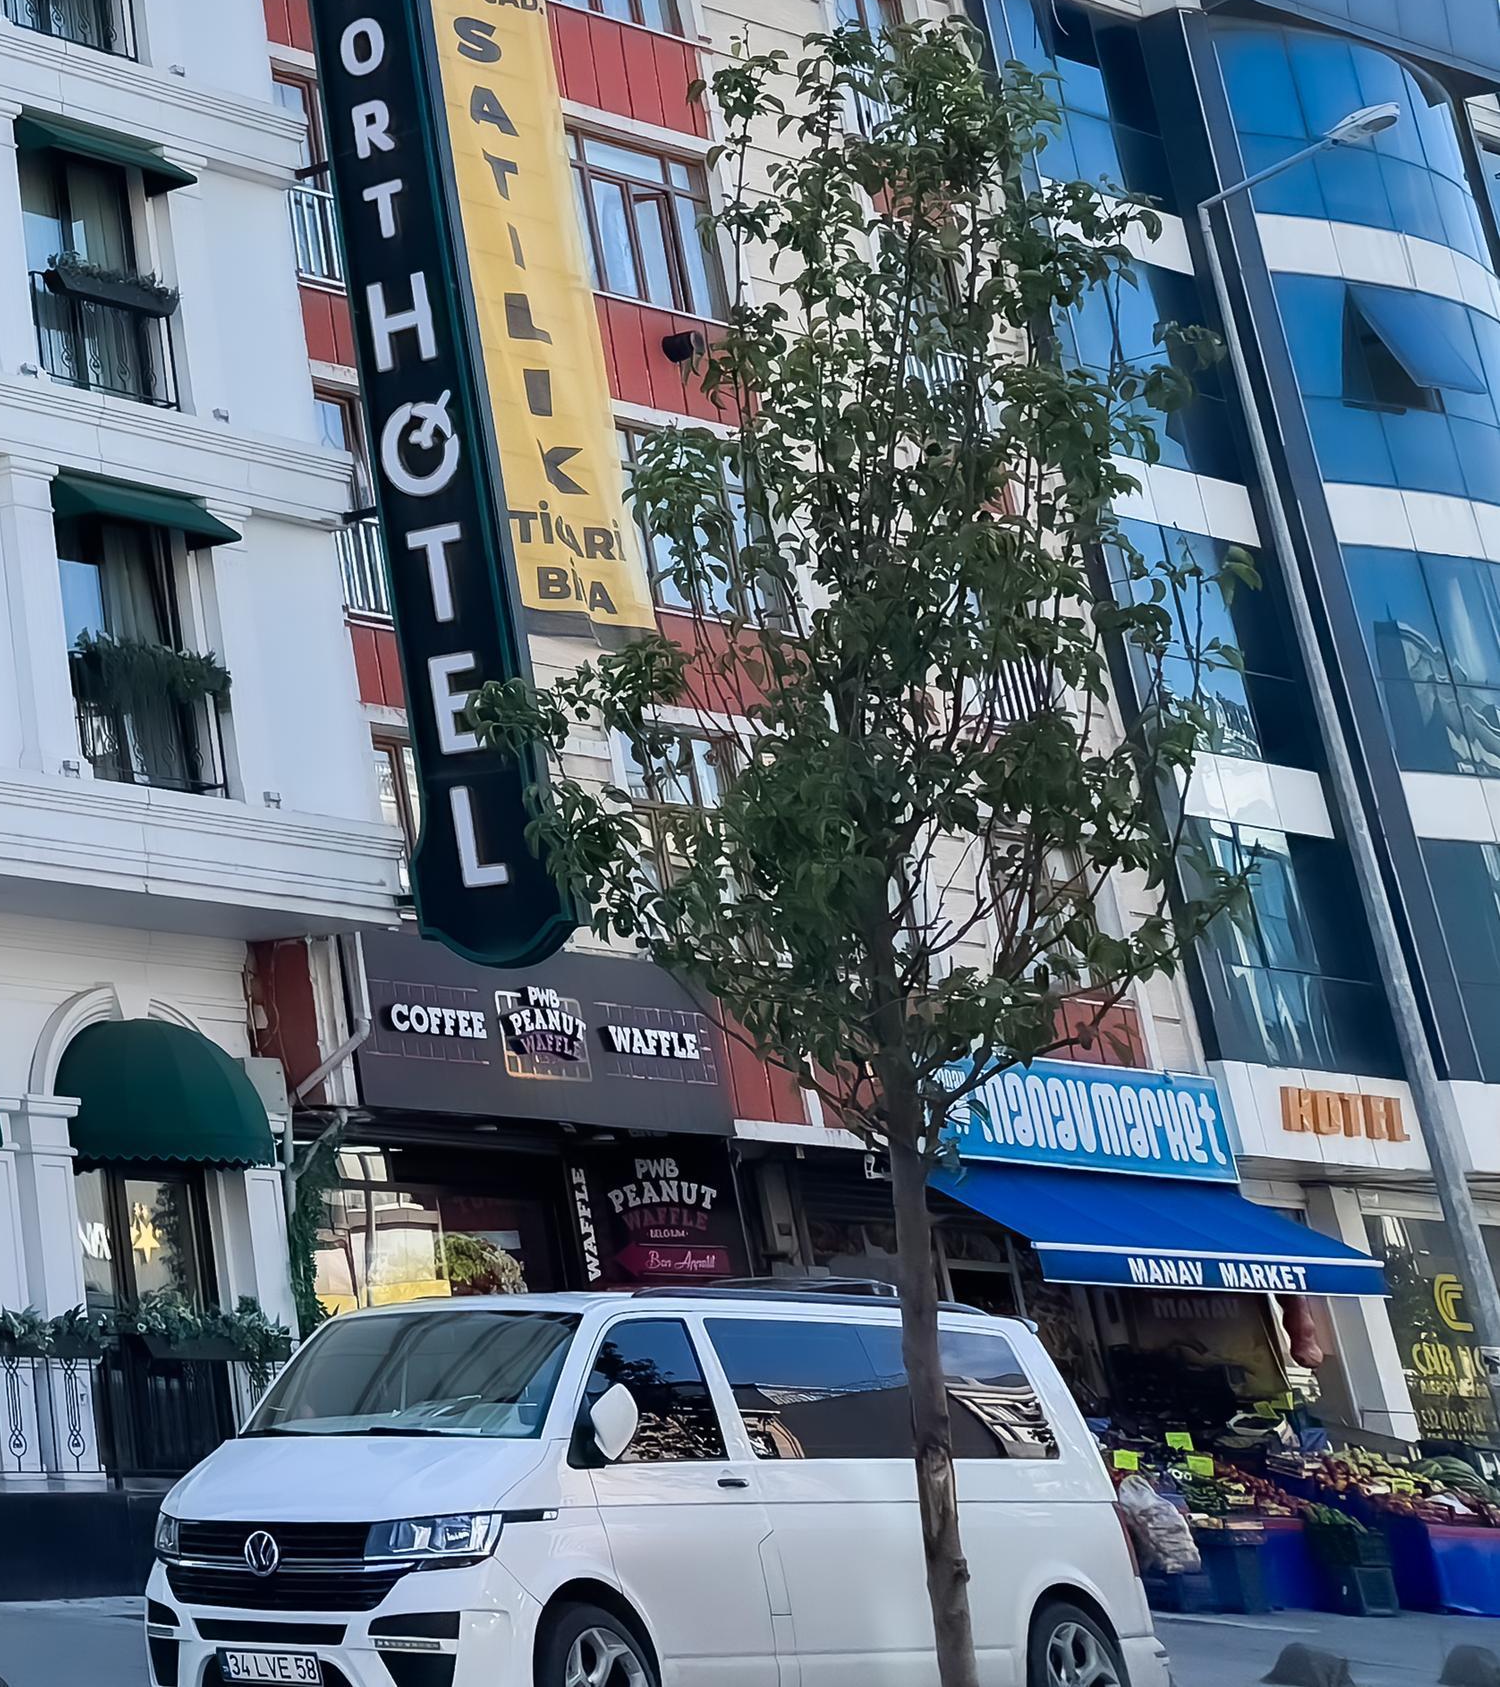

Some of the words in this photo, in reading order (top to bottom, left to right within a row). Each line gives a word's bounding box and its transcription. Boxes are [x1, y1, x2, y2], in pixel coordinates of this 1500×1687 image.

[453, 17, 590, 496] SATILIK
[366, 271, 510, 889] HOTEL
[526, 985, 561, 1009] PWB
[390, 1003, 488, 1039] COFFEE
[509, 1008, 587, 1042] PEANUT
[520, 1033, 584, 1059] WAFFLE
[607, 1024, 701, 1060] WAFFLE
[634, 1157, 680, 1180] PWB
[607, 1179, 718, 1214] PEANUT
[571, 1167, 602, 1282] WAFFLE
[1127, 1257, 1203, 1285] MANAV
[1218, 1262, 1308, 1291] MARKET
[229, 1654, 251, 1677] 34
[253, 1655, 292, 1680] LVE
[294, 1656, 317, 1680] 58
